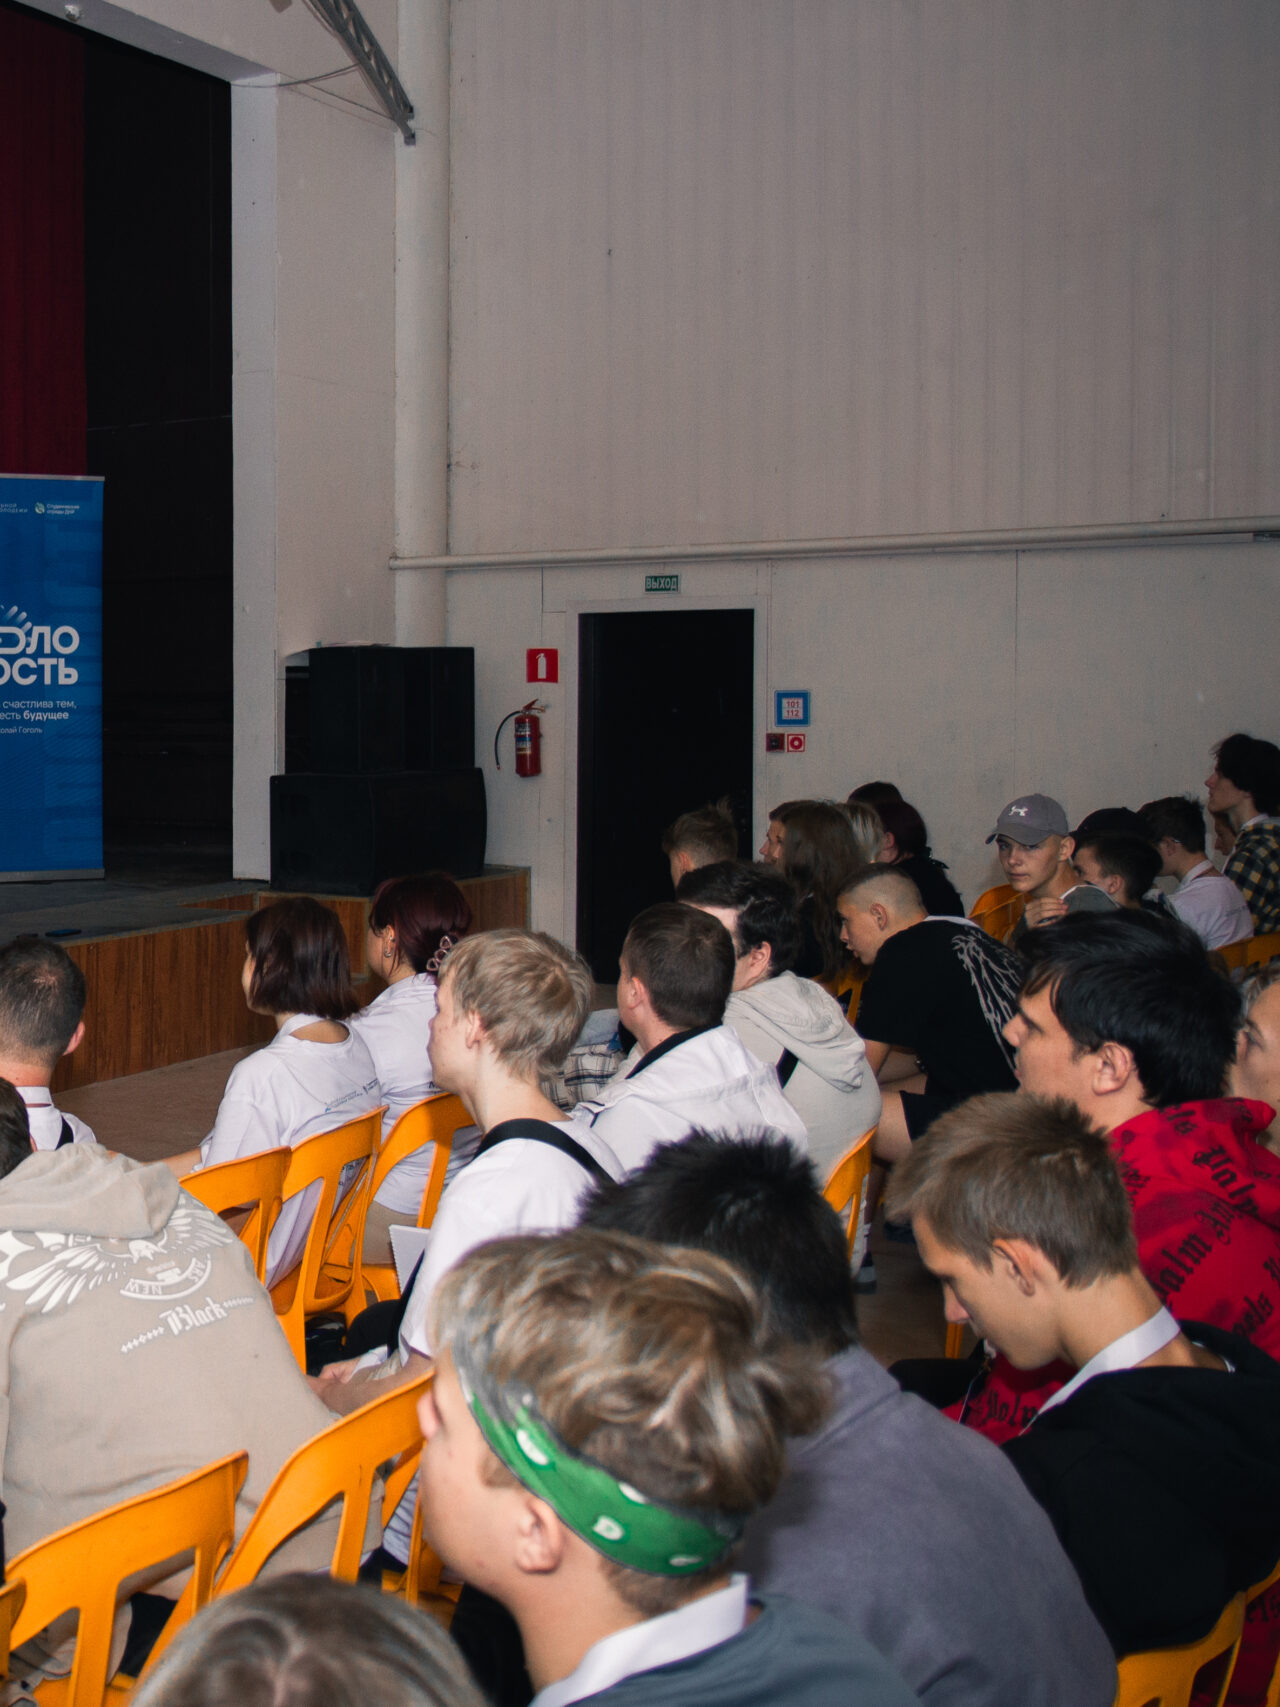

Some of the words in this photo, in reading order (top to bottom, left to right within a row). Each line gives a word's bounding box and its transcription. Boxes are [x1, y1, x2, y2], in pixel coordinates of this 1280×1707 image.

[645, 577, 677, 591] ВЫХОД
[2, 700, 54, 709] счастлива
[55, 700, 77, 710] тем,
[23, 710, 70, 722] будущее
[786, 709, 800, 717] 112
[18, 726, 43, 736] Гоголь
[159, 1296, 228, 1335] Black
